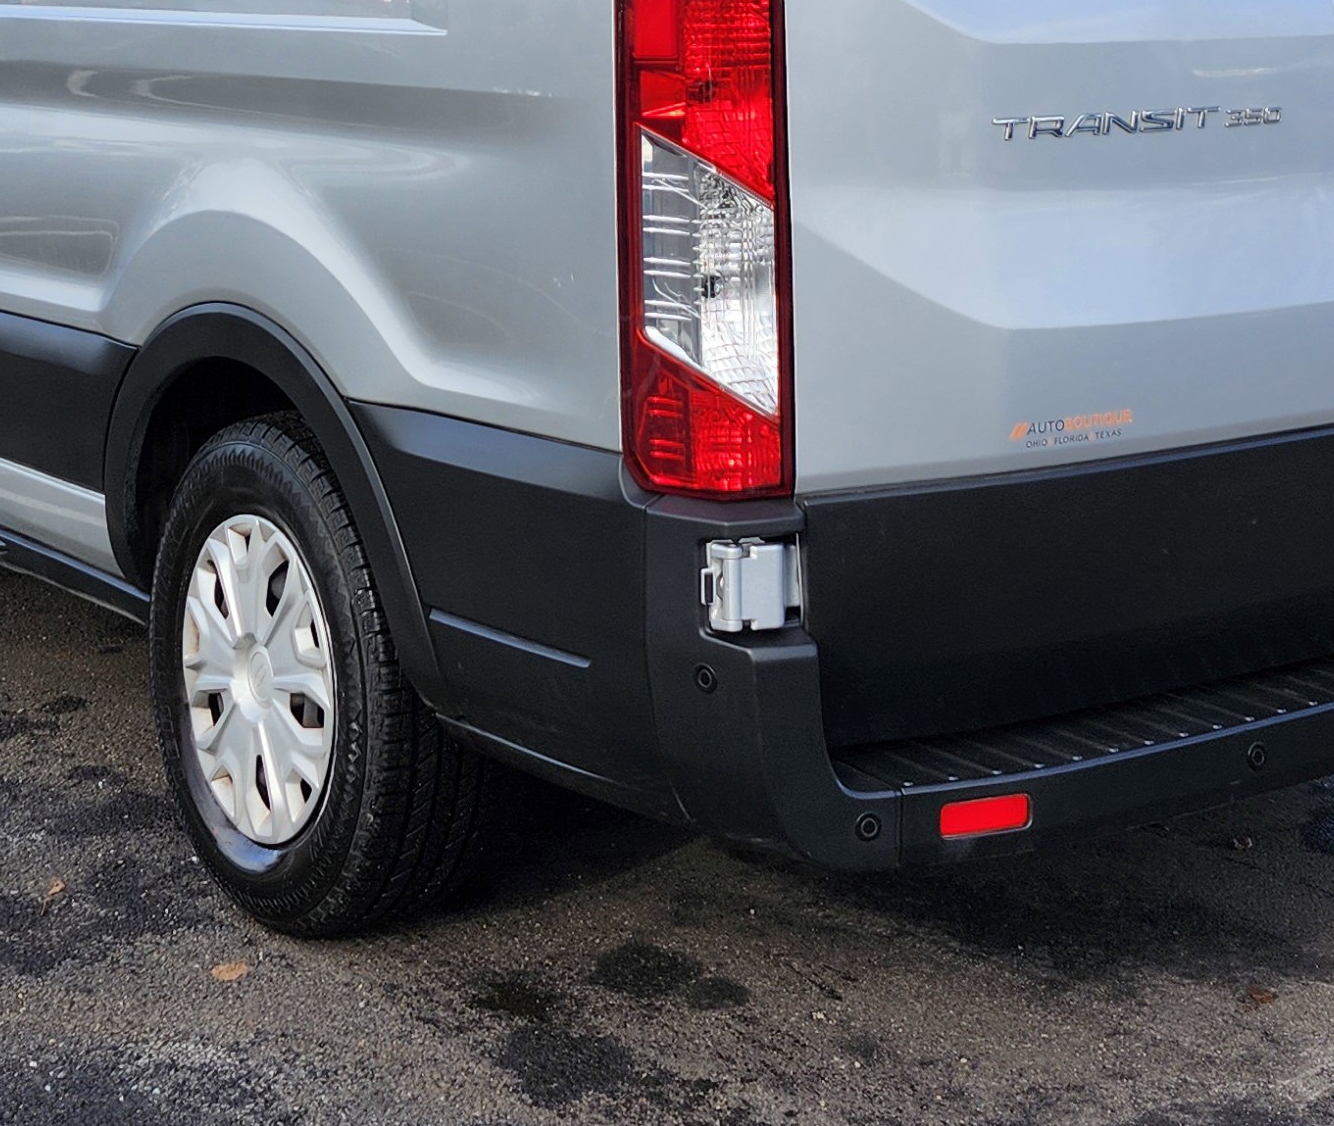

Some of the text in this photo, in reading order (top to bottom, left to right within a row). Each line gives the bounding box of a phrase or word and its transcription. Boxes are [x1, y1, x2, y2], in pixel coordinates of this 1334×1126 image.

[992, 106, 1283, 141] TRANSIT 350
[1026, 409, 1133, 436] AUTOBOUTIQUE
[1026, 428, 1122, 449] OHIO FLORIDA TEXAS
